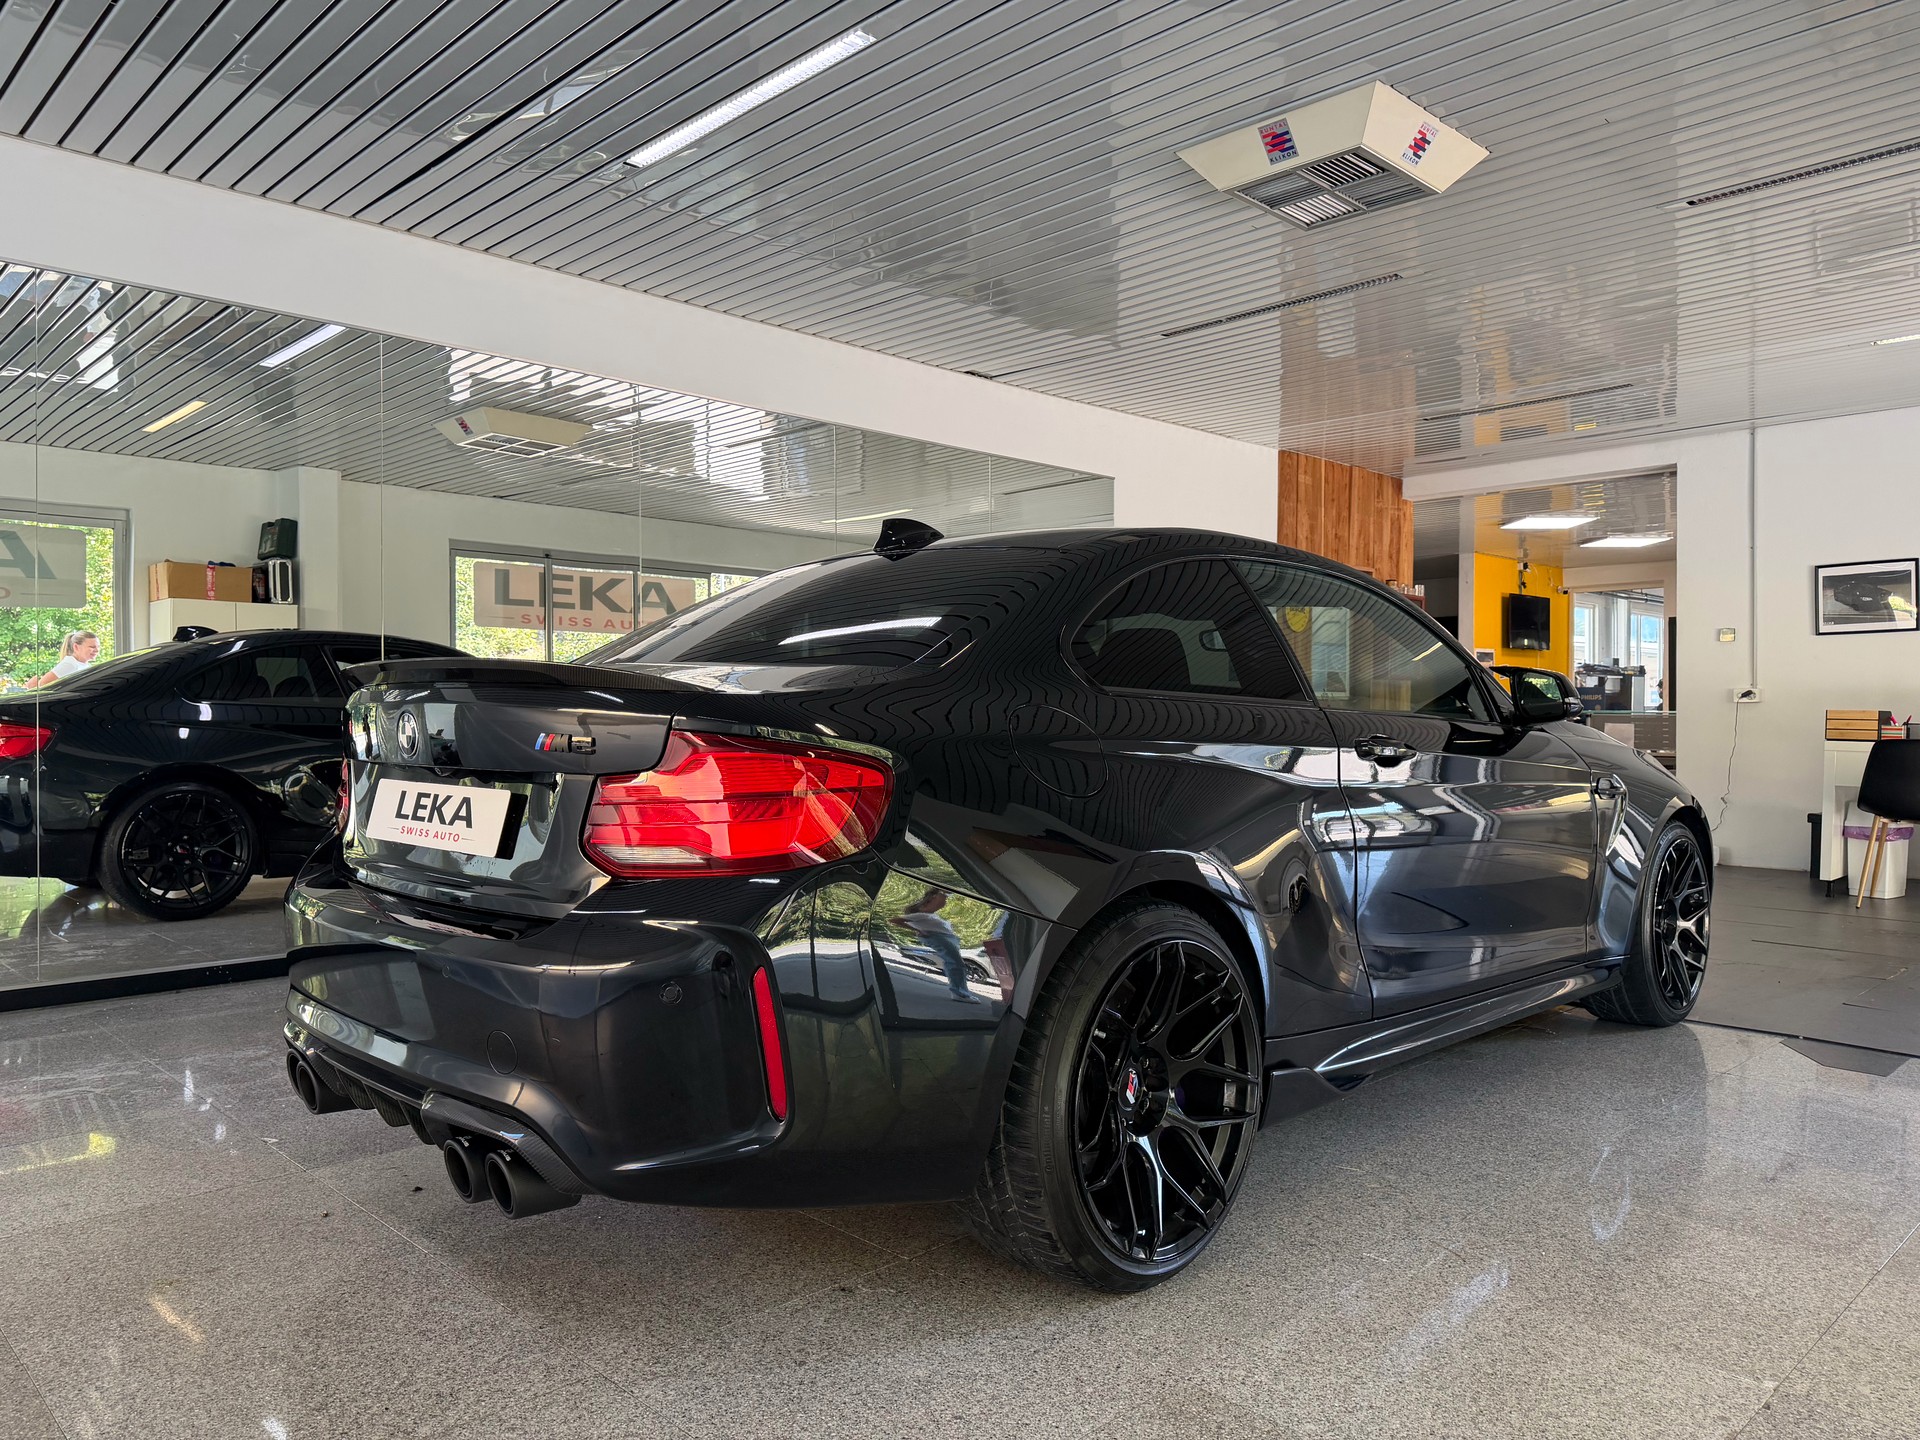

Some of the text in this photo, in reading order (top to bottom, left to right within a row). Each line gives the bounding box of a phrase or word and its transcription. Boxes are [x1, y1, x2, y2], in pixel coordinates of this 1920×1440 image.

[1260, 121, 1288, 134] RUNTAL
[1270, 150, 1297, 163] KLIKON
[494, 568, 678, 616] LEKA
[394, 790, 473, 829] LEKA
[400, 825, 461, 843] SWISS AUTO
